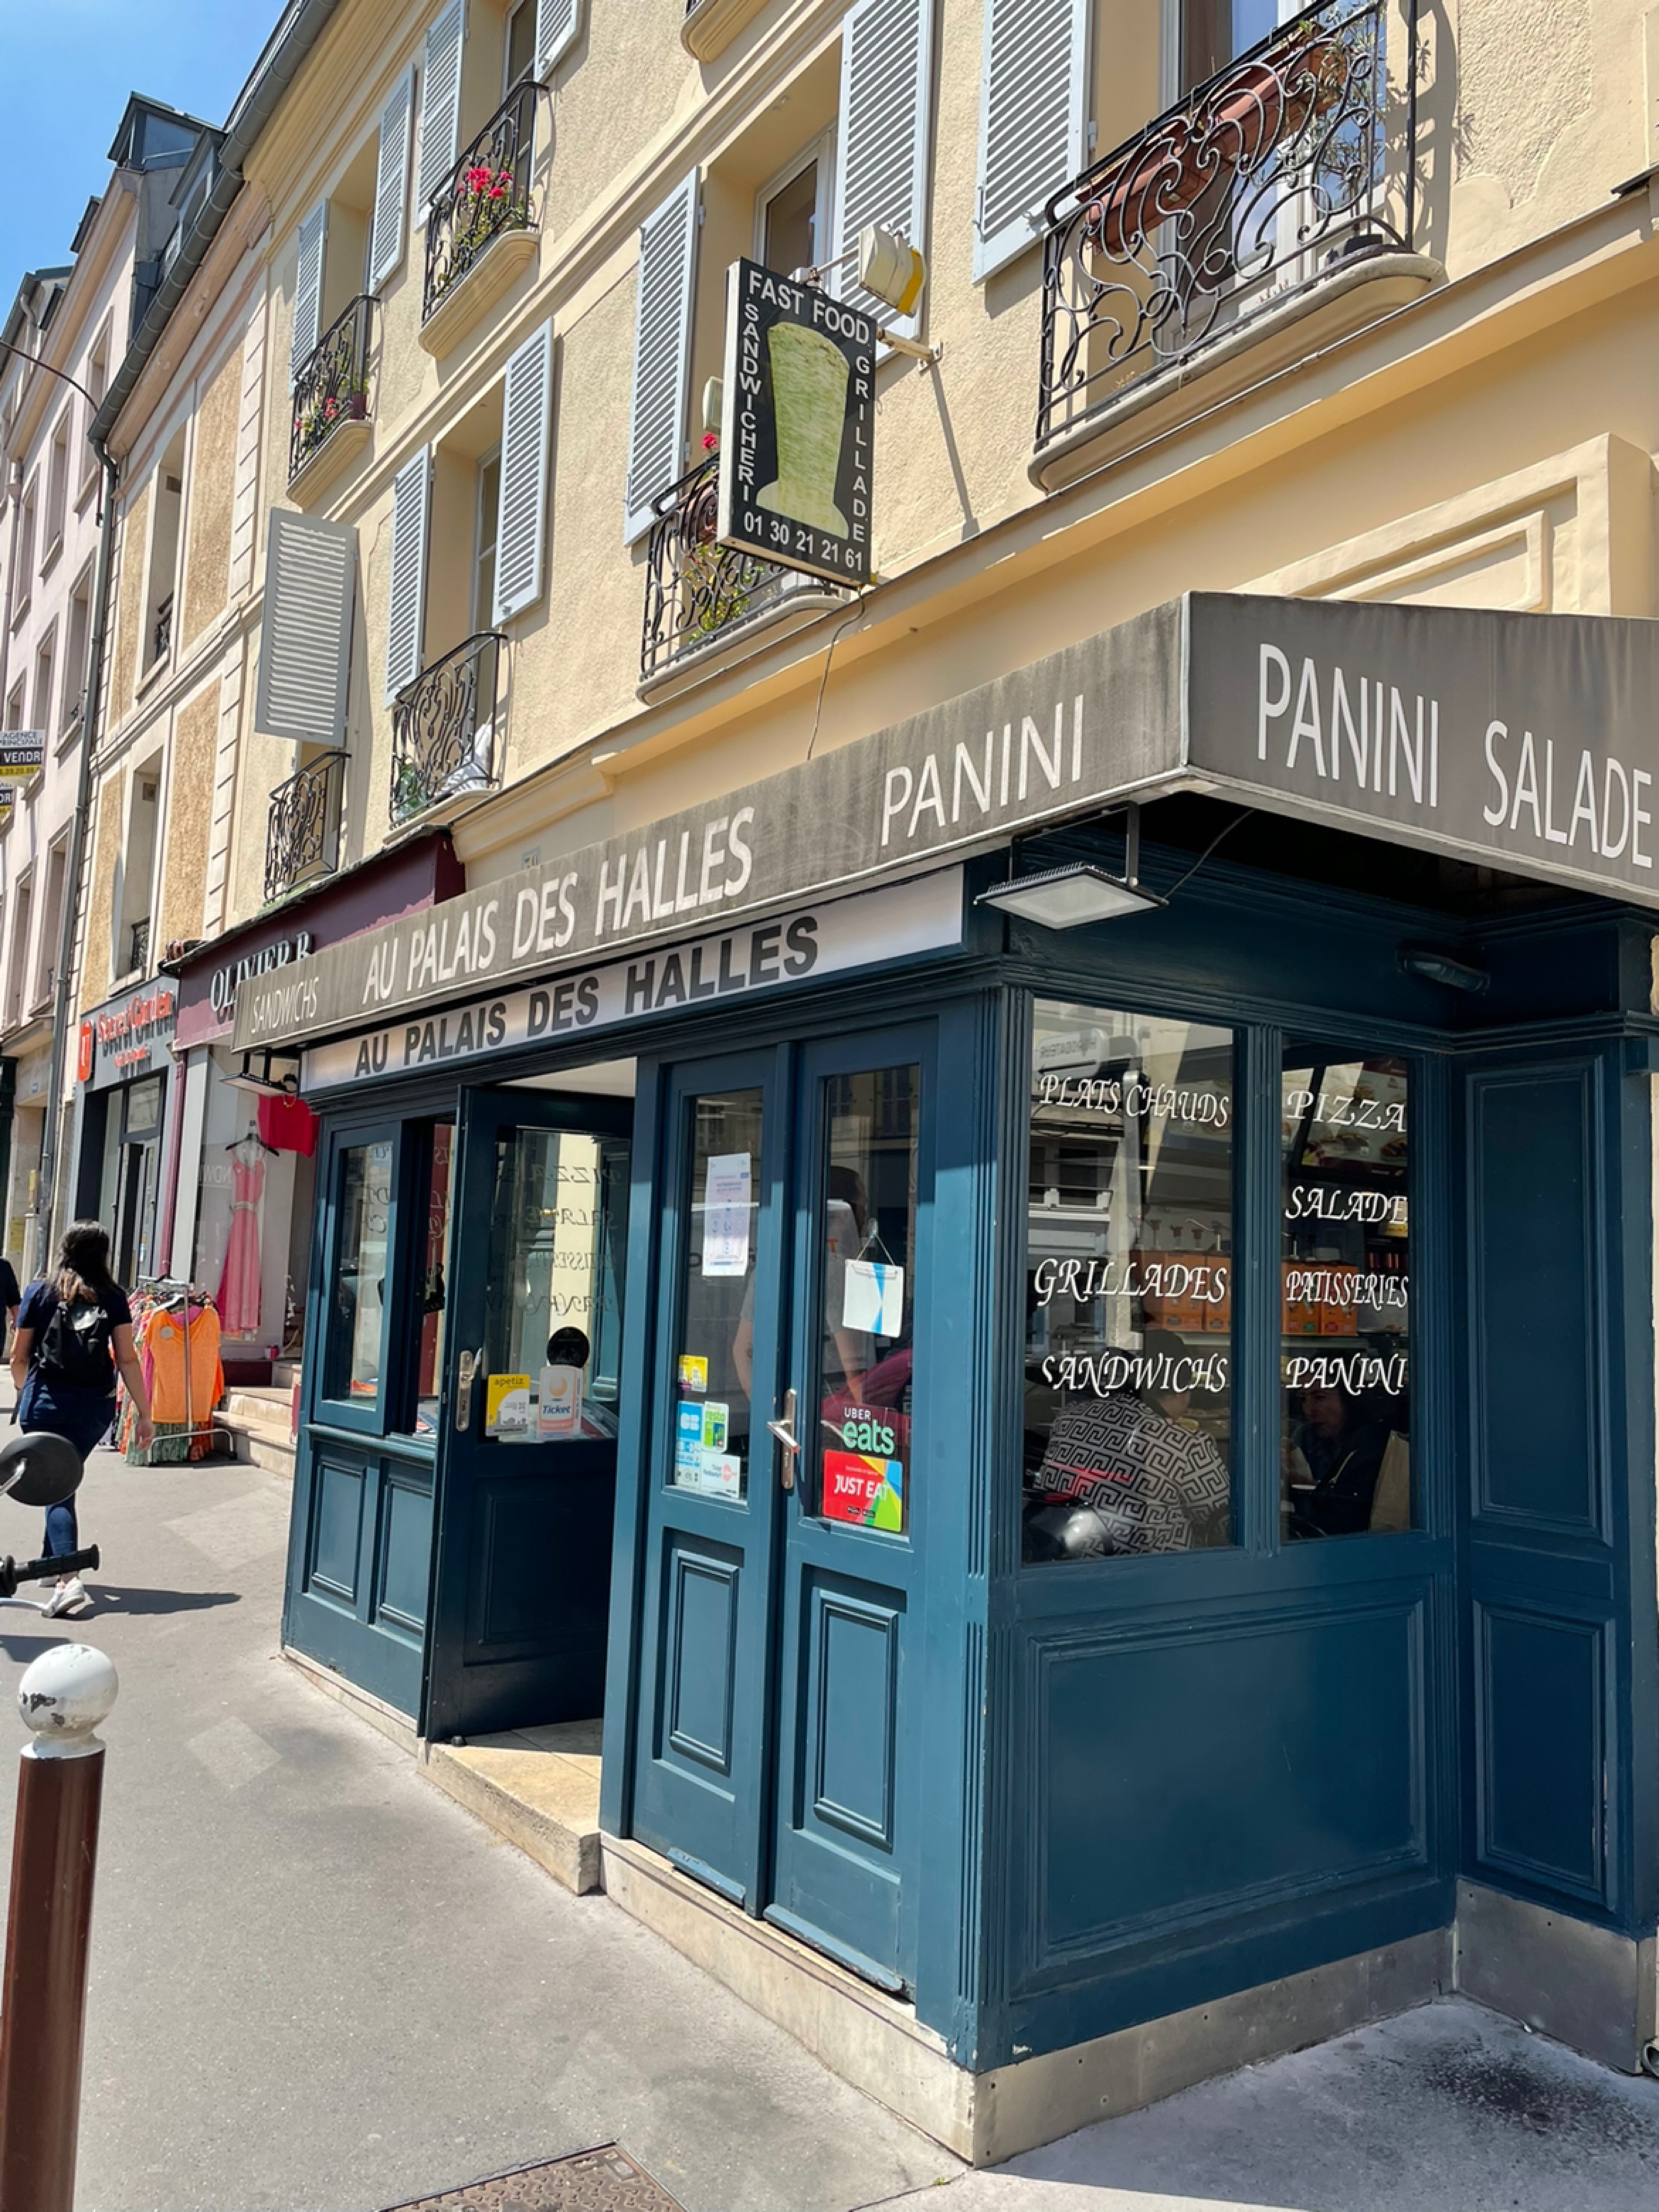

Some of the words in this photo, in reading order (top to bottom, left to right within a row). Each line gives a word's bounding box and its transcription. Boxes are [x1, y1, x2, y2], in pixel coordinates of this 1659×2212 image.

[750, 270, 804, 316] FAST
[813, 302, 870, 346] FOOD
[739, 303, 761, 502] SANDWICHERI
[853, 354, 870, 543] GRILLADE
[744, 511, 762, 536] 01
[770, 521, 790, 545] 30
[796, 531, 814, 555] 21
[821, 540, 839, 563] 21
[845, 549, 863, 571] 61
[4, 751, 43, 763] VENDR
[1258, 643, 1438, 807] PANINI
[1483, 719, 1652, 869] SALADE
[251, 976, 319, 1034] SANDWICHS
[363, 937, 398, 1005] AU
[406, 901, 499, 991] PALAIS
[512, 871, 579, 960] DES
[595, 806, 756, 938] HALLES
[881, 694, 1084, 847] PANINI
[355, 1034, 389, 1077] AU
[404, 1002, 507, 1065] PALAIS
[528, 976, 599, 1037] DES
[624, 916, 819, 1014] HALLES
[1039, 1074, 1121, 1115] PLATS
[1123, 1082, 1229, 1127] CHAUDS
[1286, 1090, 1407, 1132] PIZZA
[1285, 1185, 1408, 1224] SALADE
[1035, 1257, 1227, 1306] GRILLADES
[1286, 1270, 1409, 1311] PATISSERIES
[1042, 1351, 1227, 1398] SANDWICHS
[1286, 1353, 1408, 1395] PANINI
[543, 1405, 571, 1414] Ticket
[844, 1407, 871, 1420] UBER
[843, 1419, 895, 1455] eats
[833, 1474, 864, 1496] JUST
[866, 1480, 890, 1501] EAT
